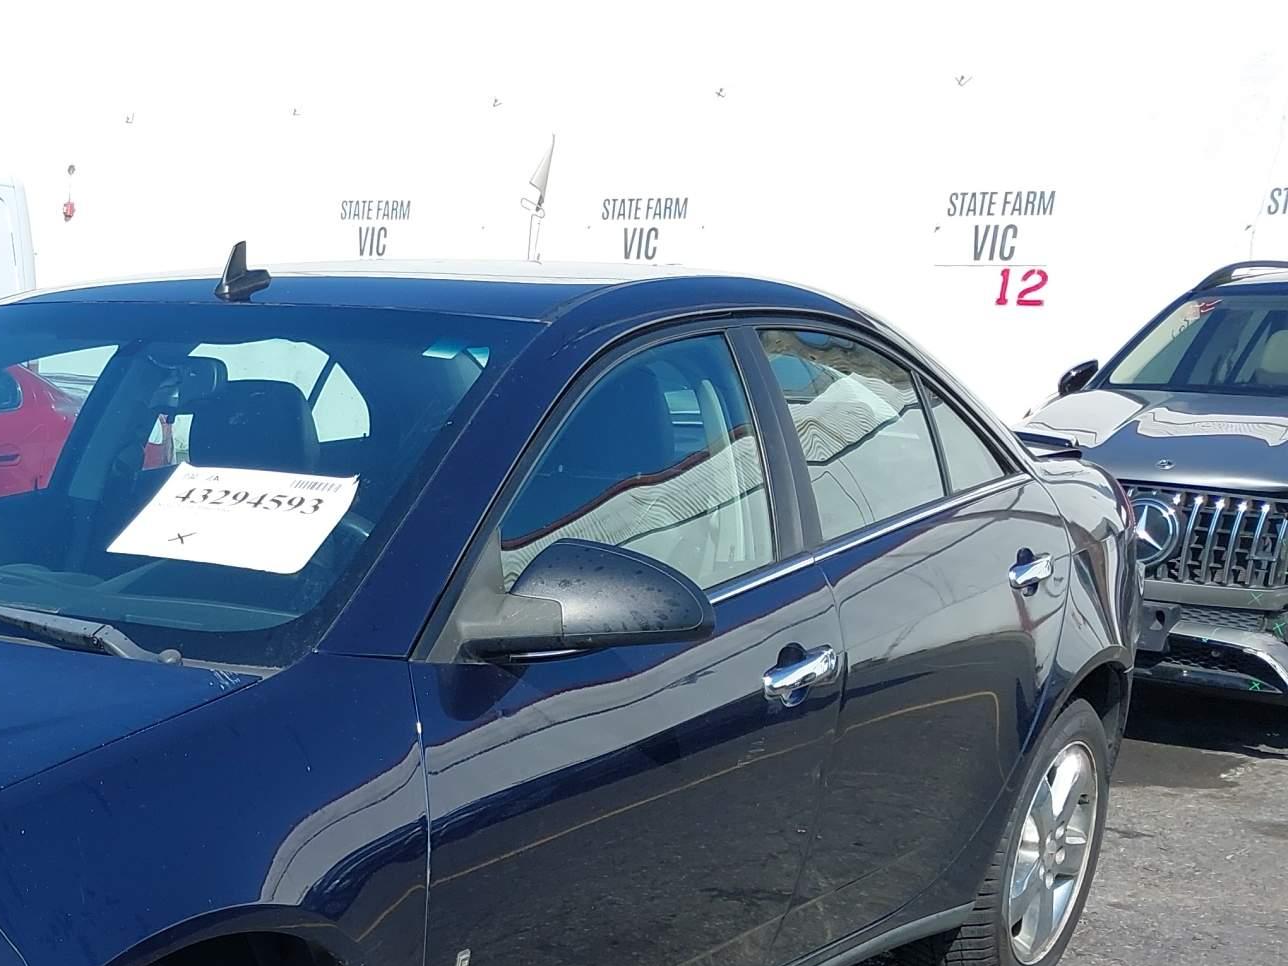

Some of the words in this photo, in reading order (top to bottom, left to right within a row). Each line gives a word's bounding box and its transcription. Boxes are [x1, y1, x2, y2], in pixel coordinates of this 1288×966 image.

[340, 200, 374, 220] STATE
[376, 200, 411, 220] FARM
[601, 198, 643, 221] STATE
[646, 197, 688, 220] FARM
[946, 191, 999, 217] STATE
[1001, 190, 1056, 216] FARM
[359, 226, 387, 257] VIC
[623, 227, 658, 260] VIC
[973, 224, 1019, 261] VIC
[994, 267, 1049, 308] 12
[175, 487, 324, 515] 43294593
